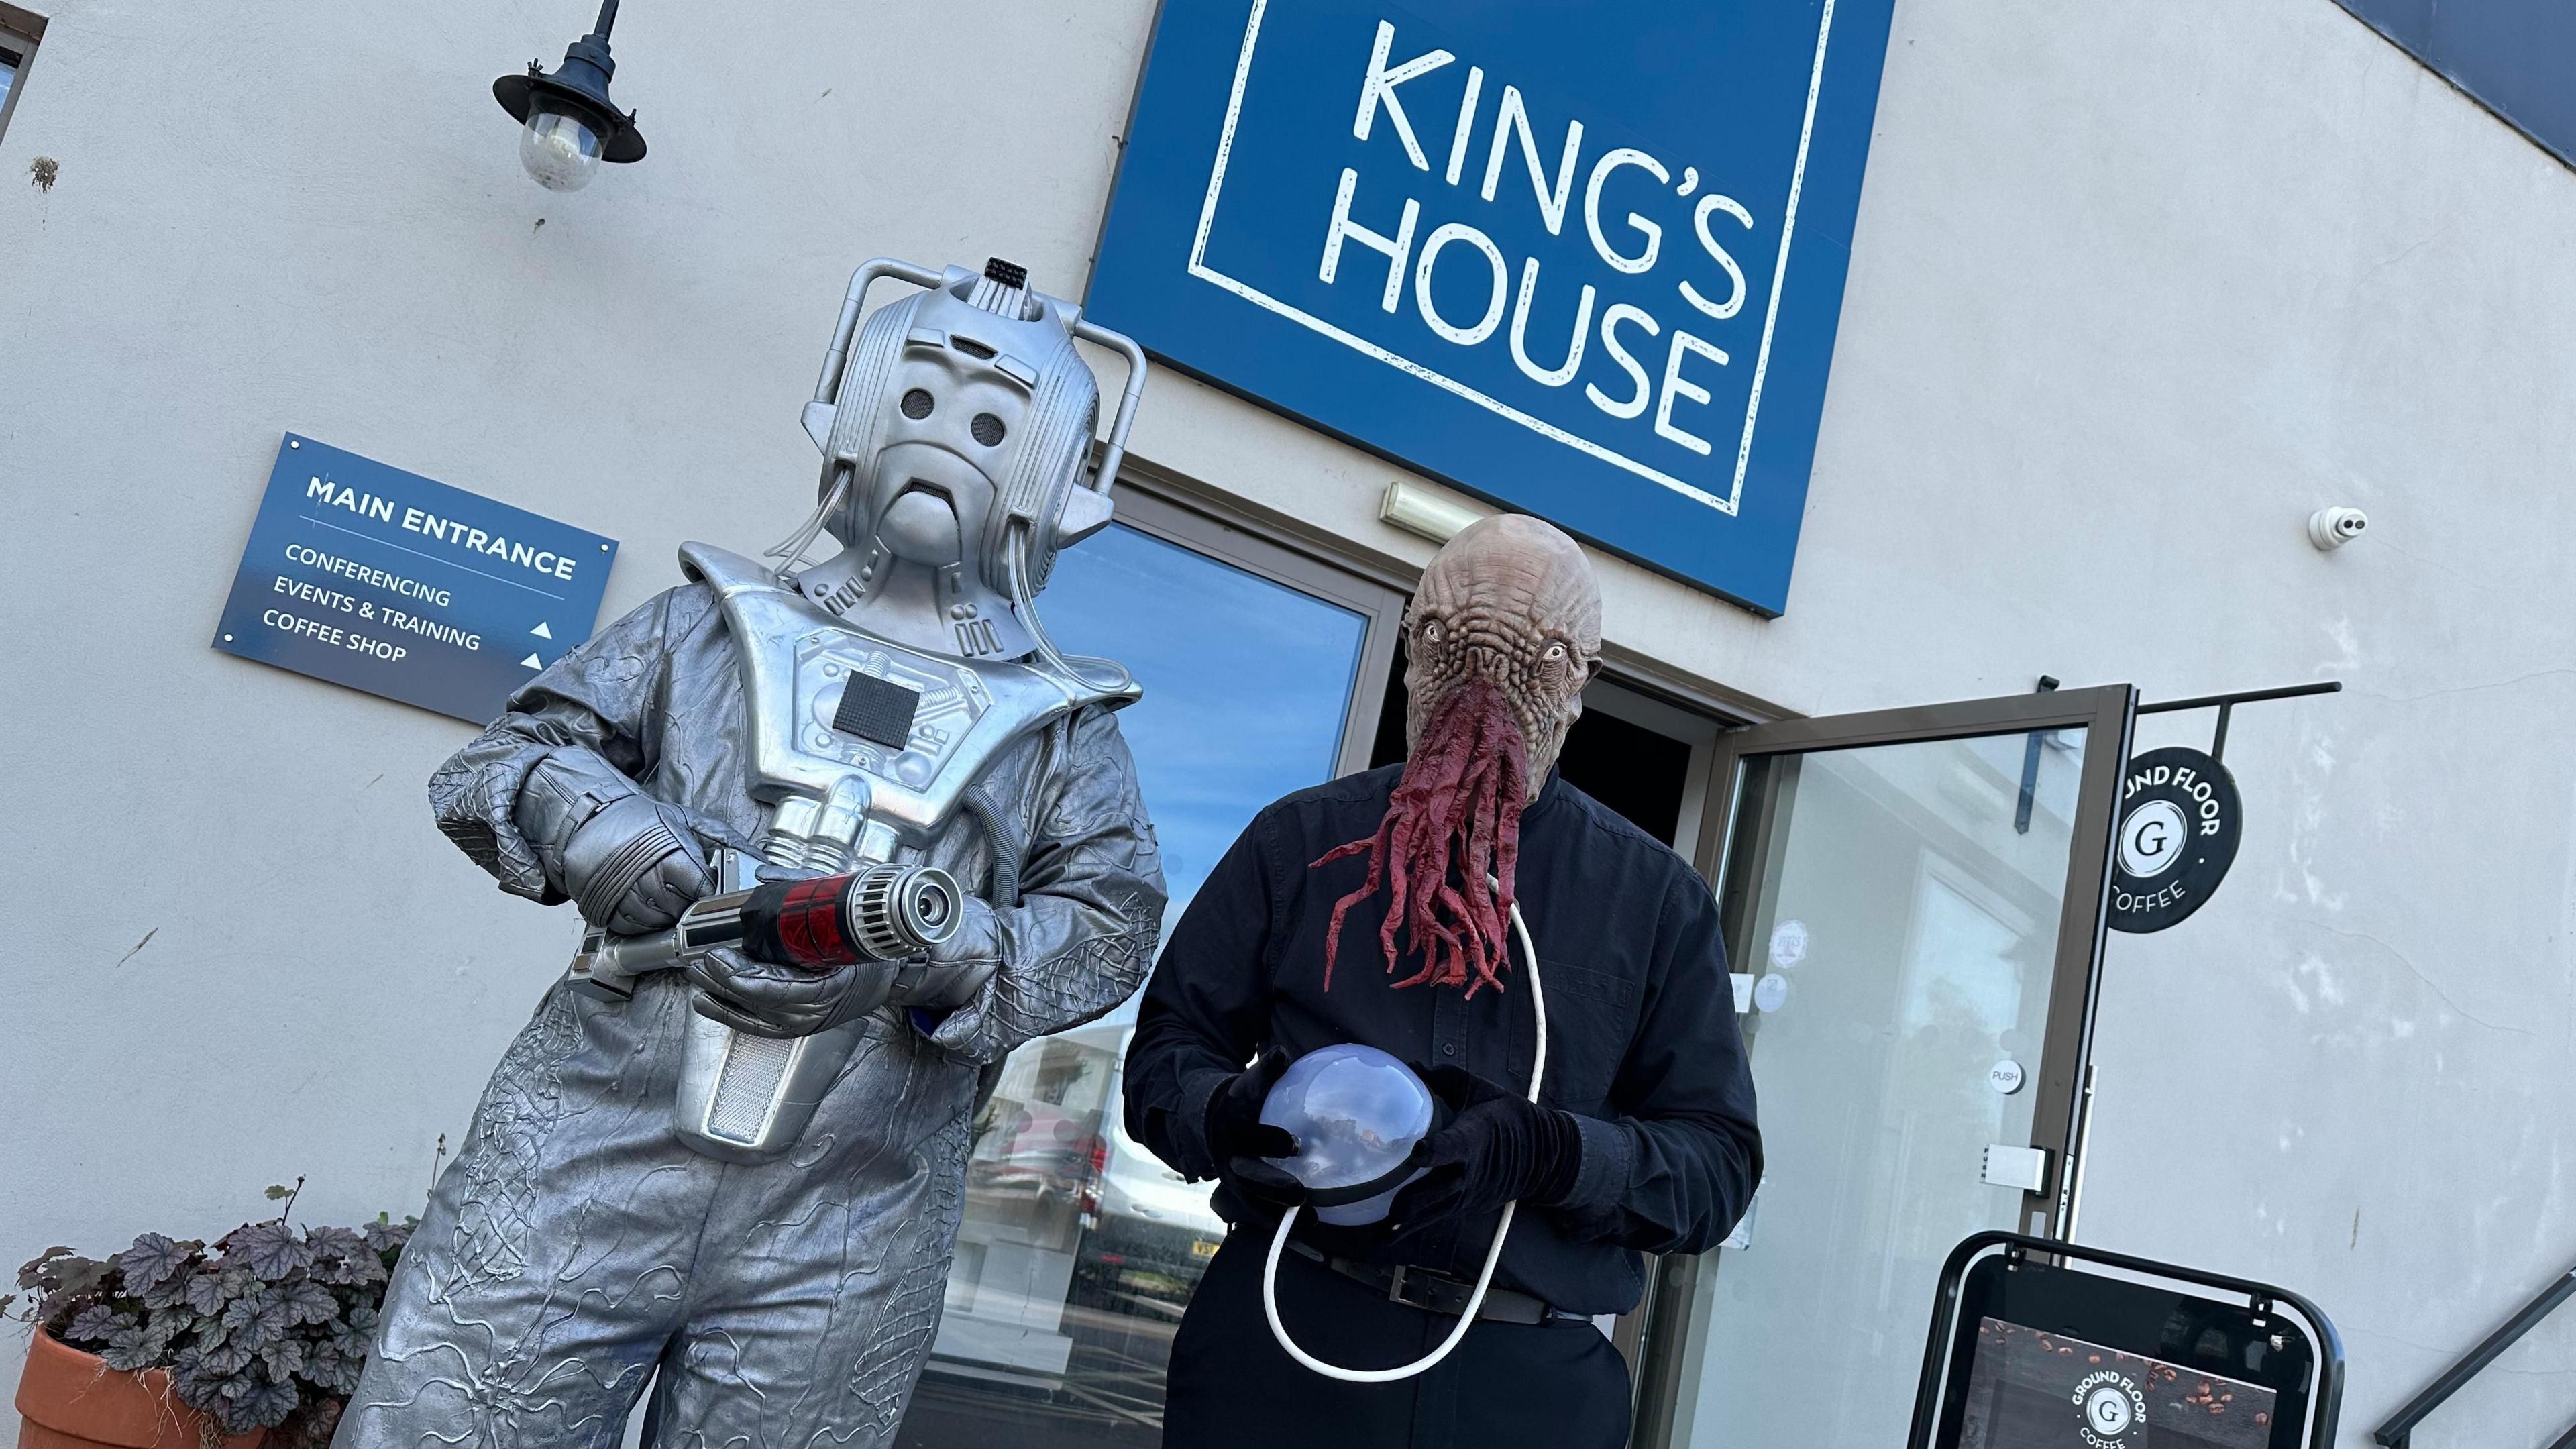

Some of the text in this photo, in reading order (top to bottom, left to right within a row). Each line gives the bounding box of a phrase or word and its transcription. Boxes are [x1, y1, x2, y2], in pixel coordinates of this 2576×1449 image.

[1354, 19, 1754, 319] KING'S
[1319, 167, 1729, 455] HOUSE
[306, 476, 576, 580] MAIN ENTRANCE
[285, 544, 451, 607] CONFERENCING
[263, 608, 407, 663] COFFEE SHOP
[274, 576, 481, 651] EVENTS & TRAINING
[2171, 767, 2220, 836] FLOOR
[2135, 821, 2167, 856] G
[1992, 1070, 2019, 1082] PUSH
[2072, 1371, 2147, 1423] GROUND FLOOR
[2098, 1401, 2118, 1422] G
